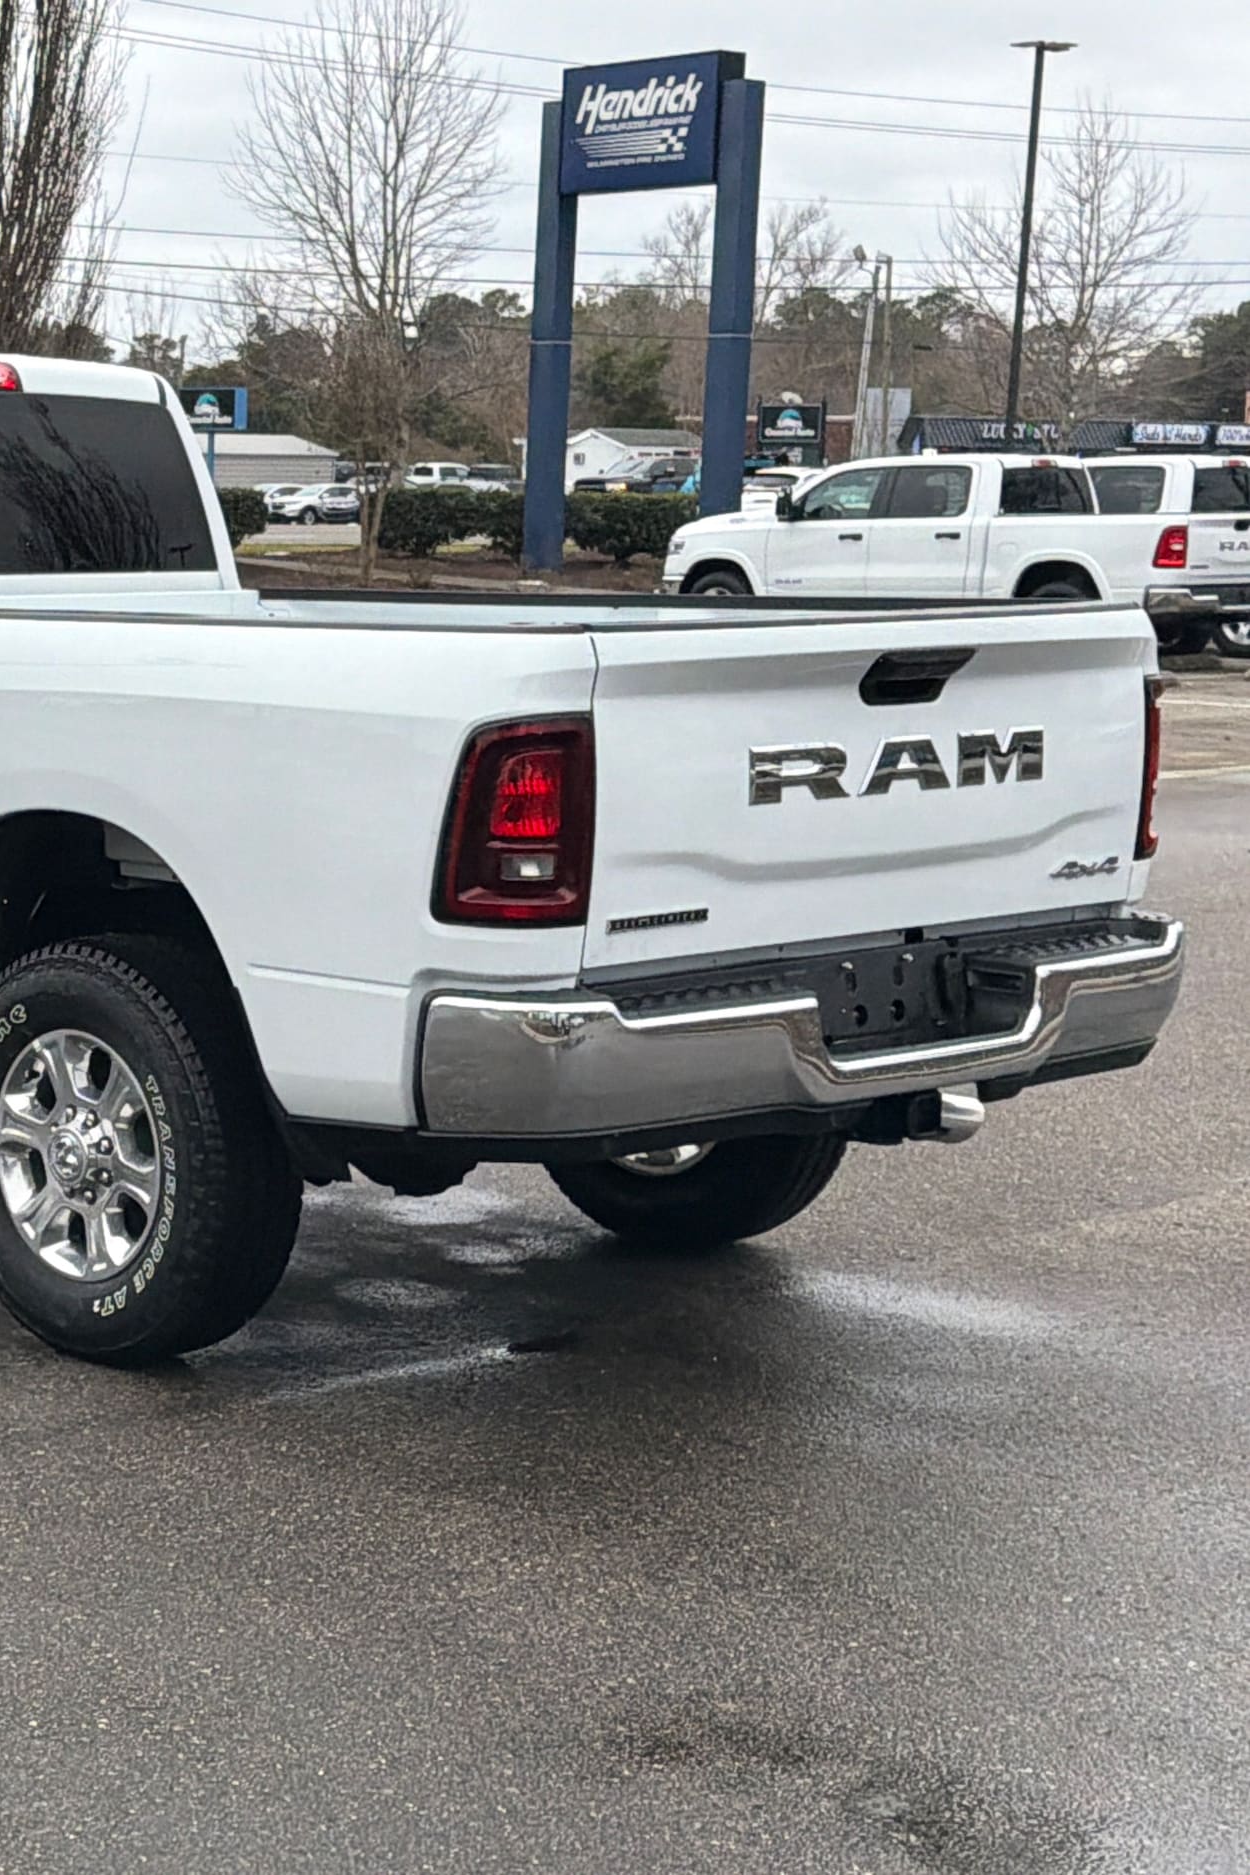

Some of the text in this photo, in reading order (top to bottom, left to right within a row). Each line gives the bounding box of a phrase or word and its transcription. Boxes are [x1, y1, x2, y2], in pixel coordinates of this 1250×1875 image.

[575, 73, 703, 135] Hendrick
[748, 725, 1044, 806] RAM
[133, 1074, 177, 1294] TRANSFORCE
